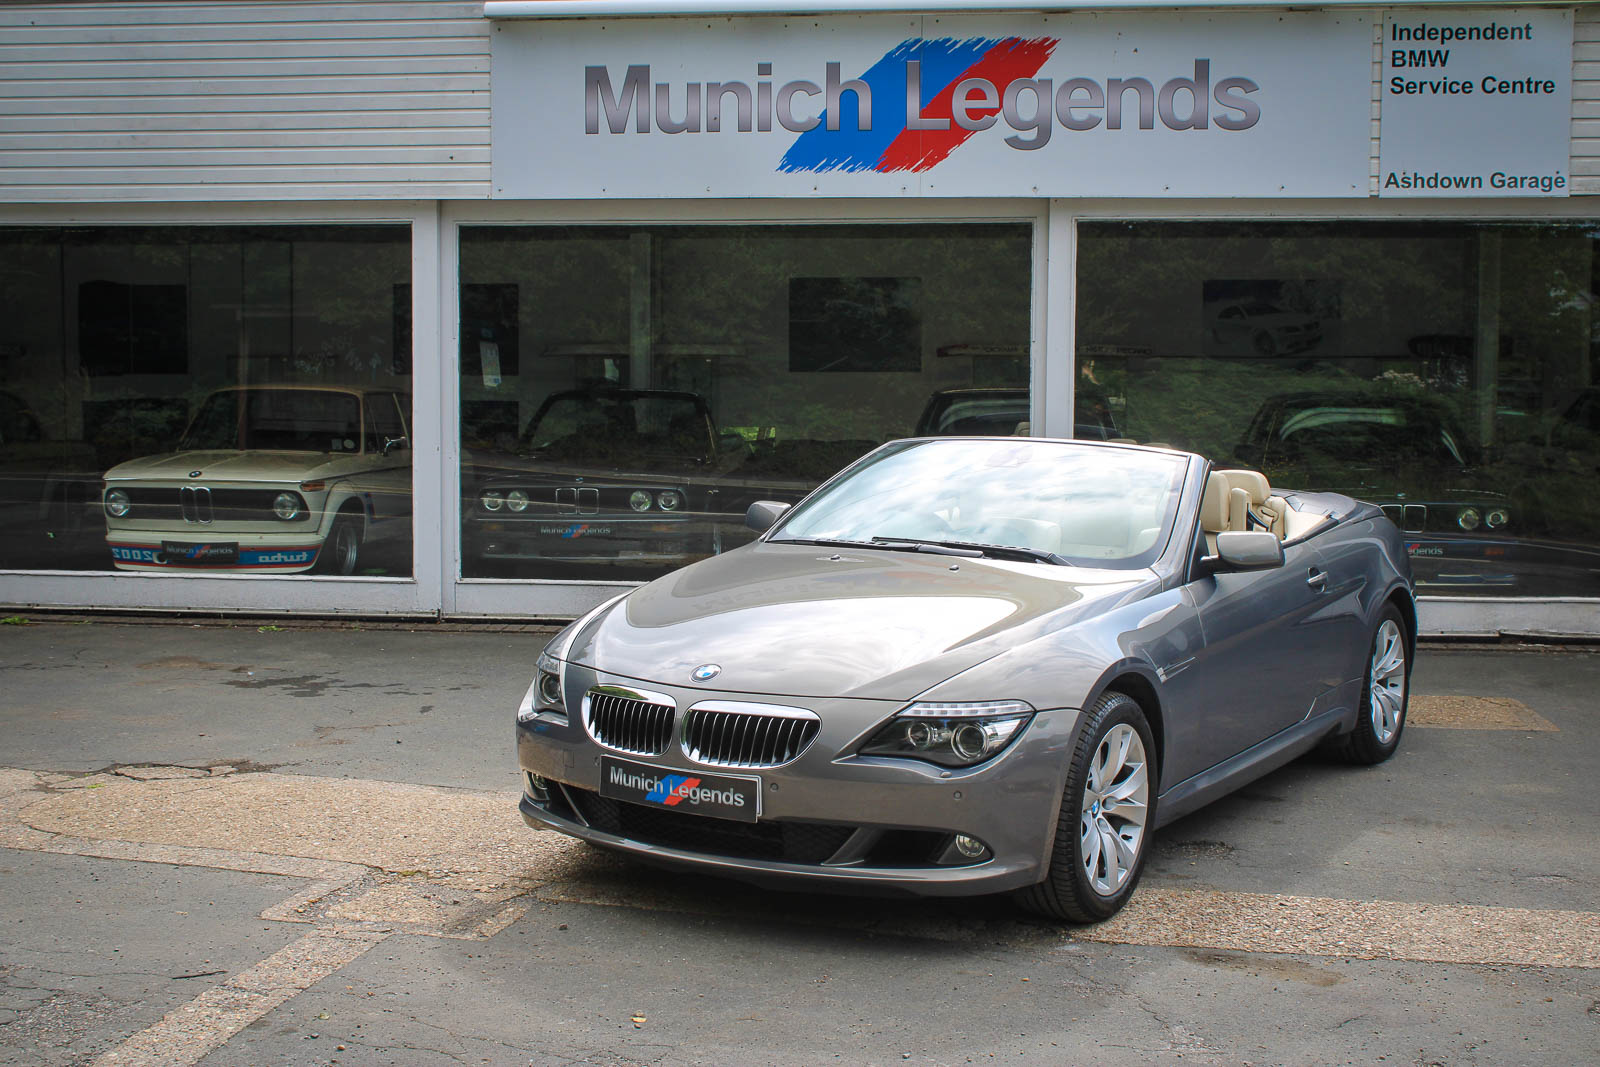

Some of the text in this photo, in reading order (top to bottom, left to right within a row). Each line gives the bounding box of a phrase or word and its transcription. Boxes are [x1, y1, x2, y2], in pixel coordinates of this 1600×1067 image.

[1391, 23, 1532, 45] Independent
[1391, 50, 1450, 68] BMW
[1390, 76, 1555, 94] Service Centre
[584, 58, 1260, 150] Munich Legends
[1384, 172, 1566, 192] Ashdown Garage
[1407, 546, 1444, 557] egends
[610, 766, 745, 807] Munich Legends
